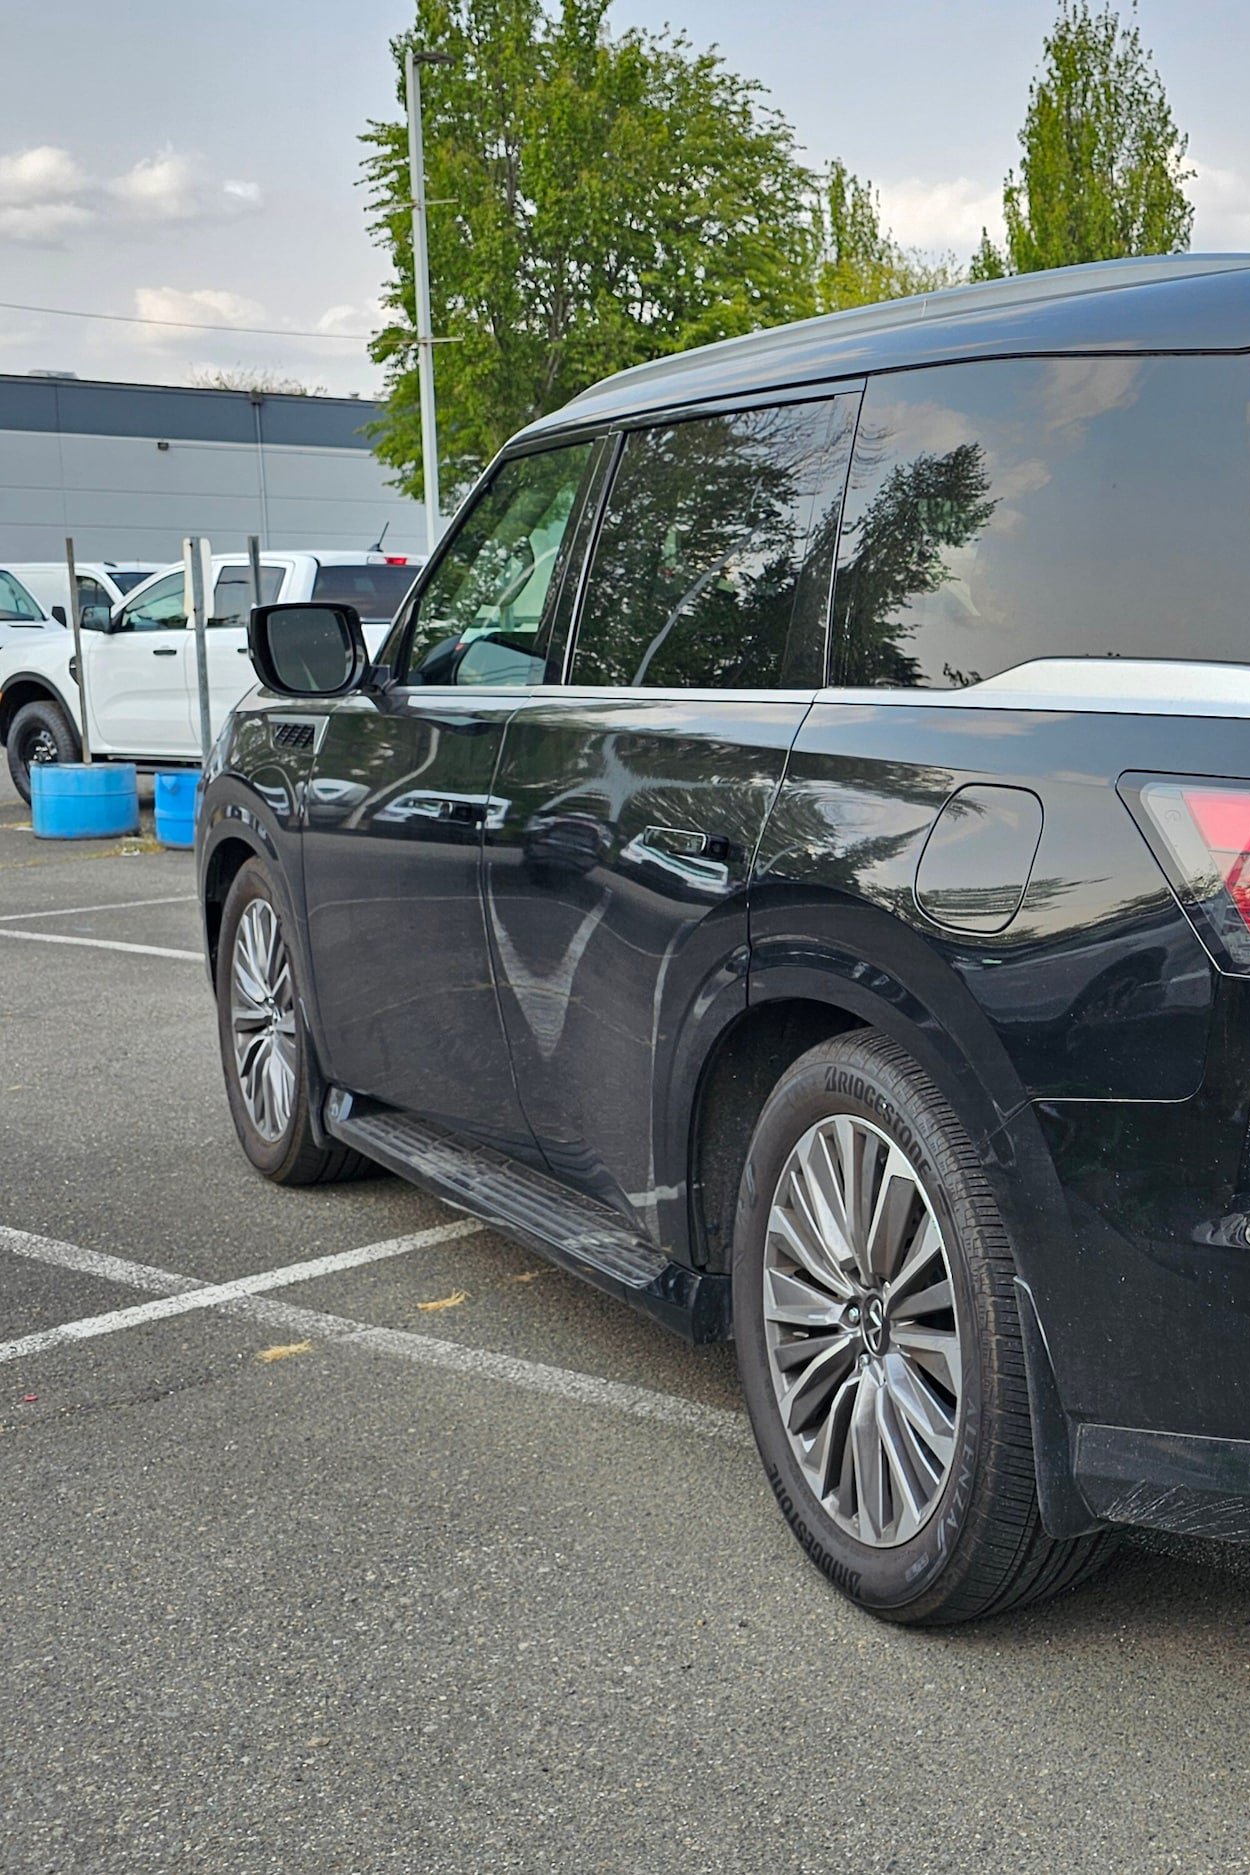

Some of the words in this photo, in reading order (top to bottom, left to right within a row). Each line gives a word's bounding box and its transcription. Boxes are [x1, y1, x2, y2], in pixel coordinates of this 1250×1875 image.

[825, 1066, 932, 1178] BRIDGESTONE
[947, 1398, 978, 1528] ALENZA
[768, 1463, 863, 1599] BRIDGESTONE
